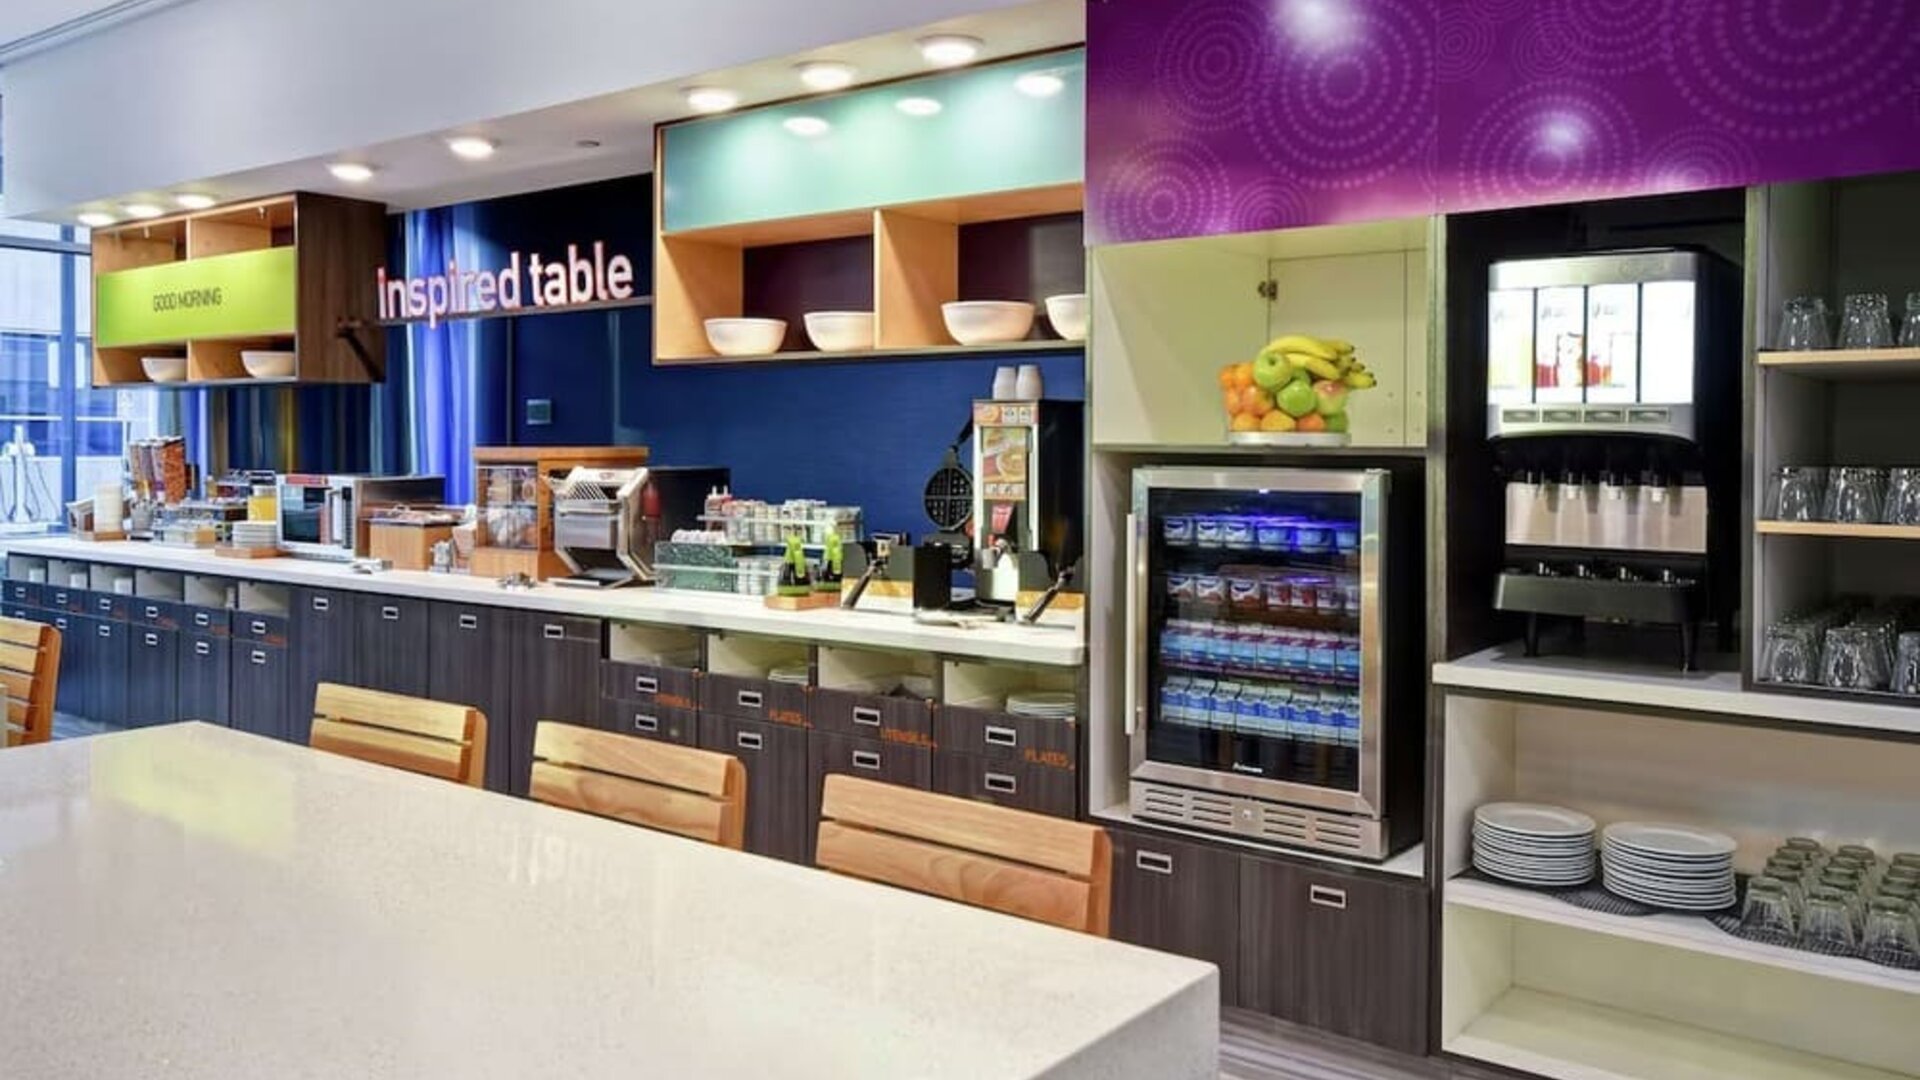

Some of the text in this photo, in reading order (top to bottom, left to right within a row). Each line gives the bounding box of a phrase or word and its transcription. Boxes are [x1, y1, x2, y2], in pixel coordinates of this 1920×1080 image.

[153, 287, 223, 312] GOOD MORNING
[377, 240, 634, 330] inspired table
